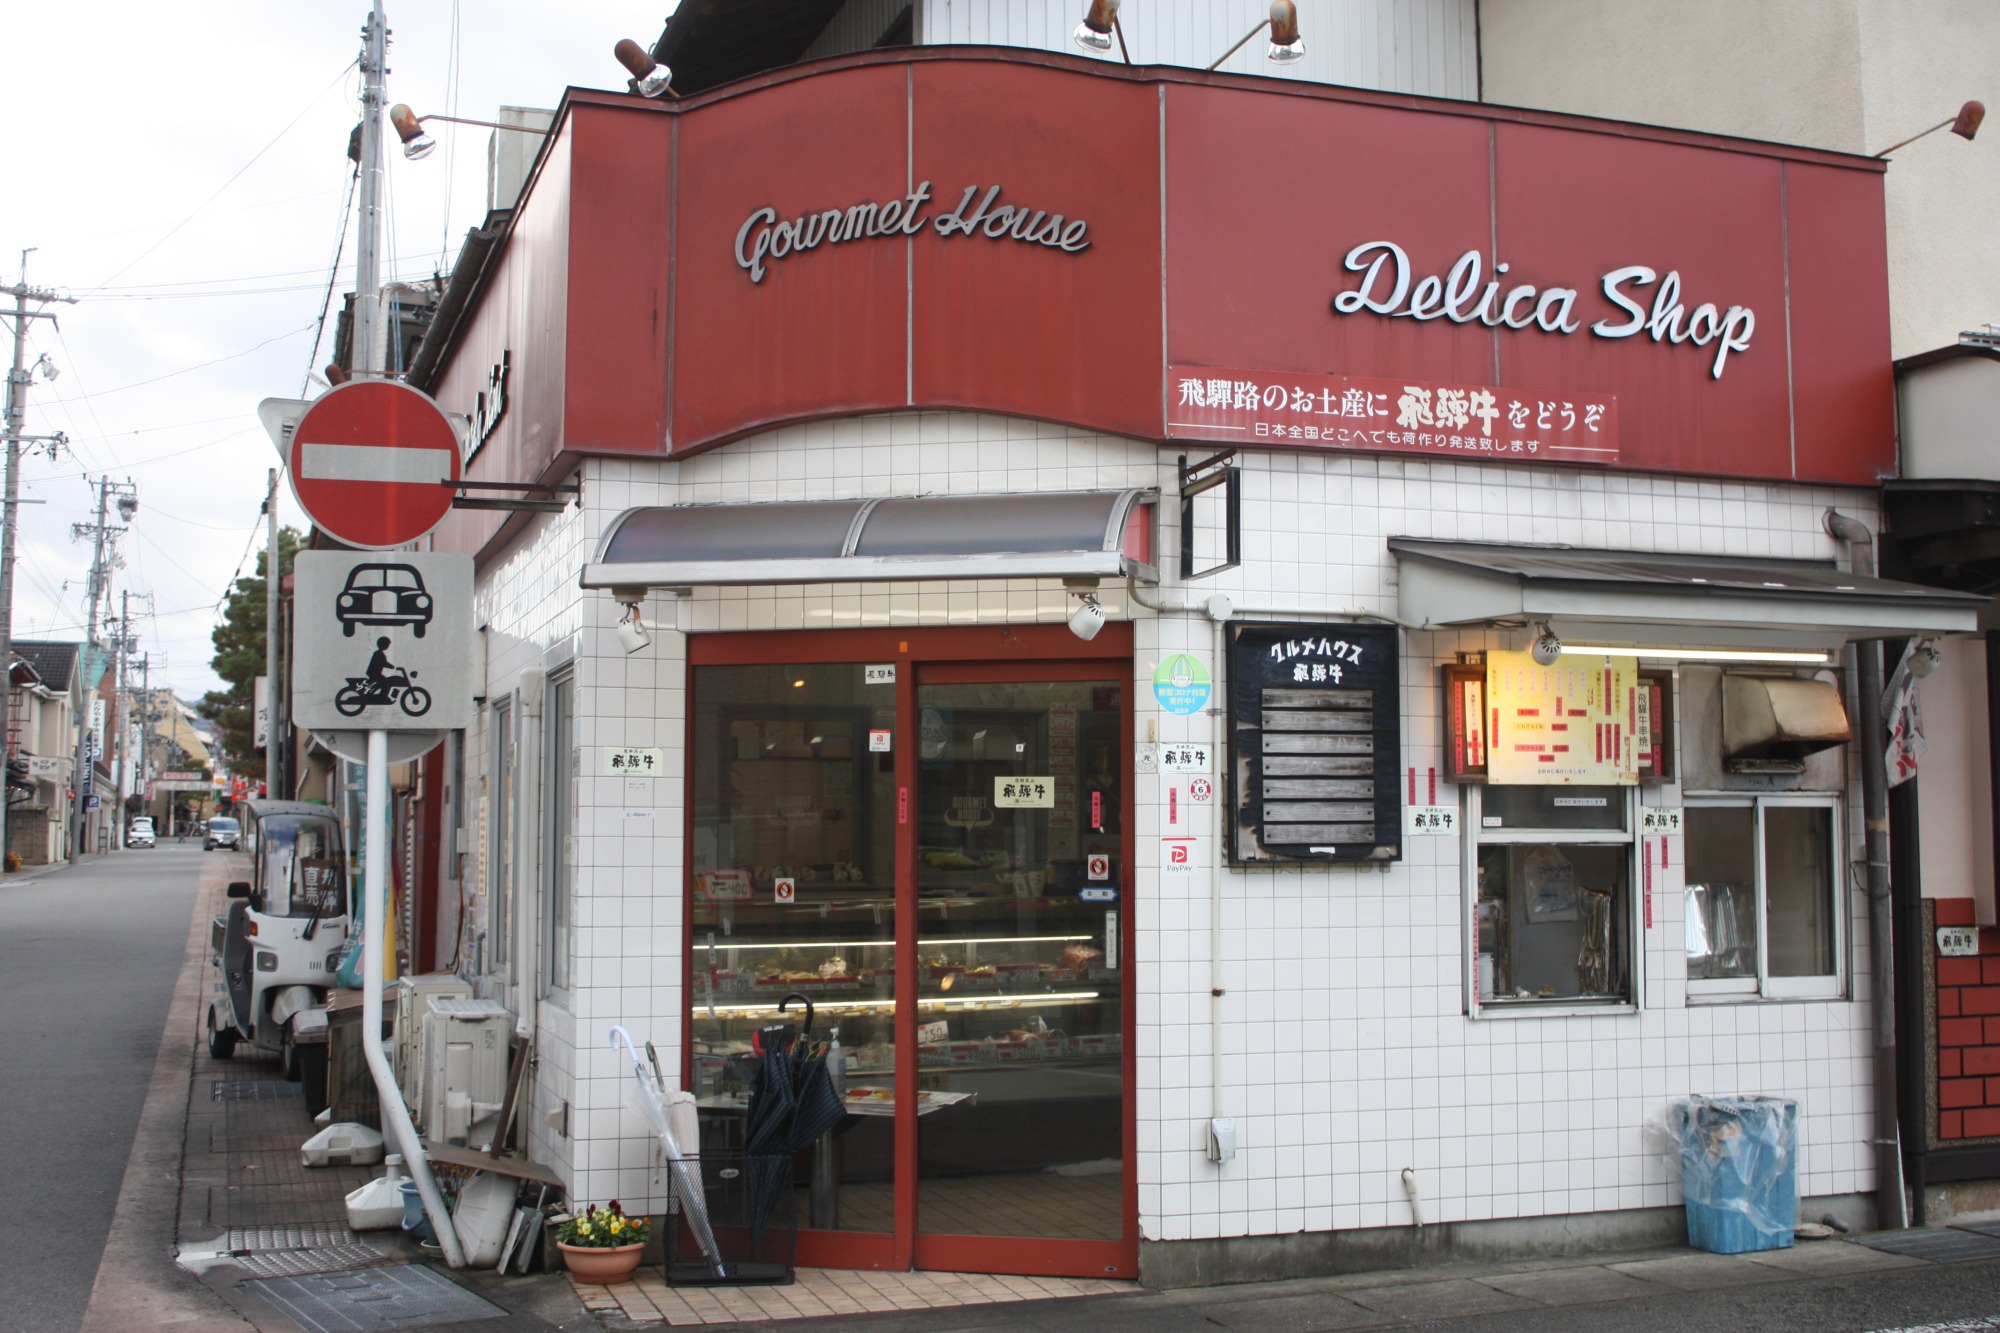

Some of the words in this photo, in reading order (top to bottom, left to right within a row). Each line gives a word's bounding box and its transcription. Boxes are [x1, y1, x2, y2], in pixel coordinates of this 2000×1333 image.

[735, 181, 931, 284] Gourmet
[934, 184, 1092, 252] House
[1334, 241, 1582, 334] Delica
[1590, 265, 1756, 379] Shop
[1508, 400, 1605, 432] をどうぞ
[1255, 422, 1540, 453] 日本全国どこへでも荷作り発送致します
[1158, 688, 1206, 697] 新型コロナ対策
[612, 754, 654, 770] 飛騨牛
[1164, 750, 1206, 766] 飛騨牛
[1003, 784, 1046, 799] 飛騨牛
[1415, 813, 1453, 828] 飛騨牛
[1645, 814, 1679, 828] 飛騨牛
[1167, 865, 1192, 873] PayPay
[304, 866, 320, 906] 直売
[1942, 934, 1972, 948] 飛騨牛
